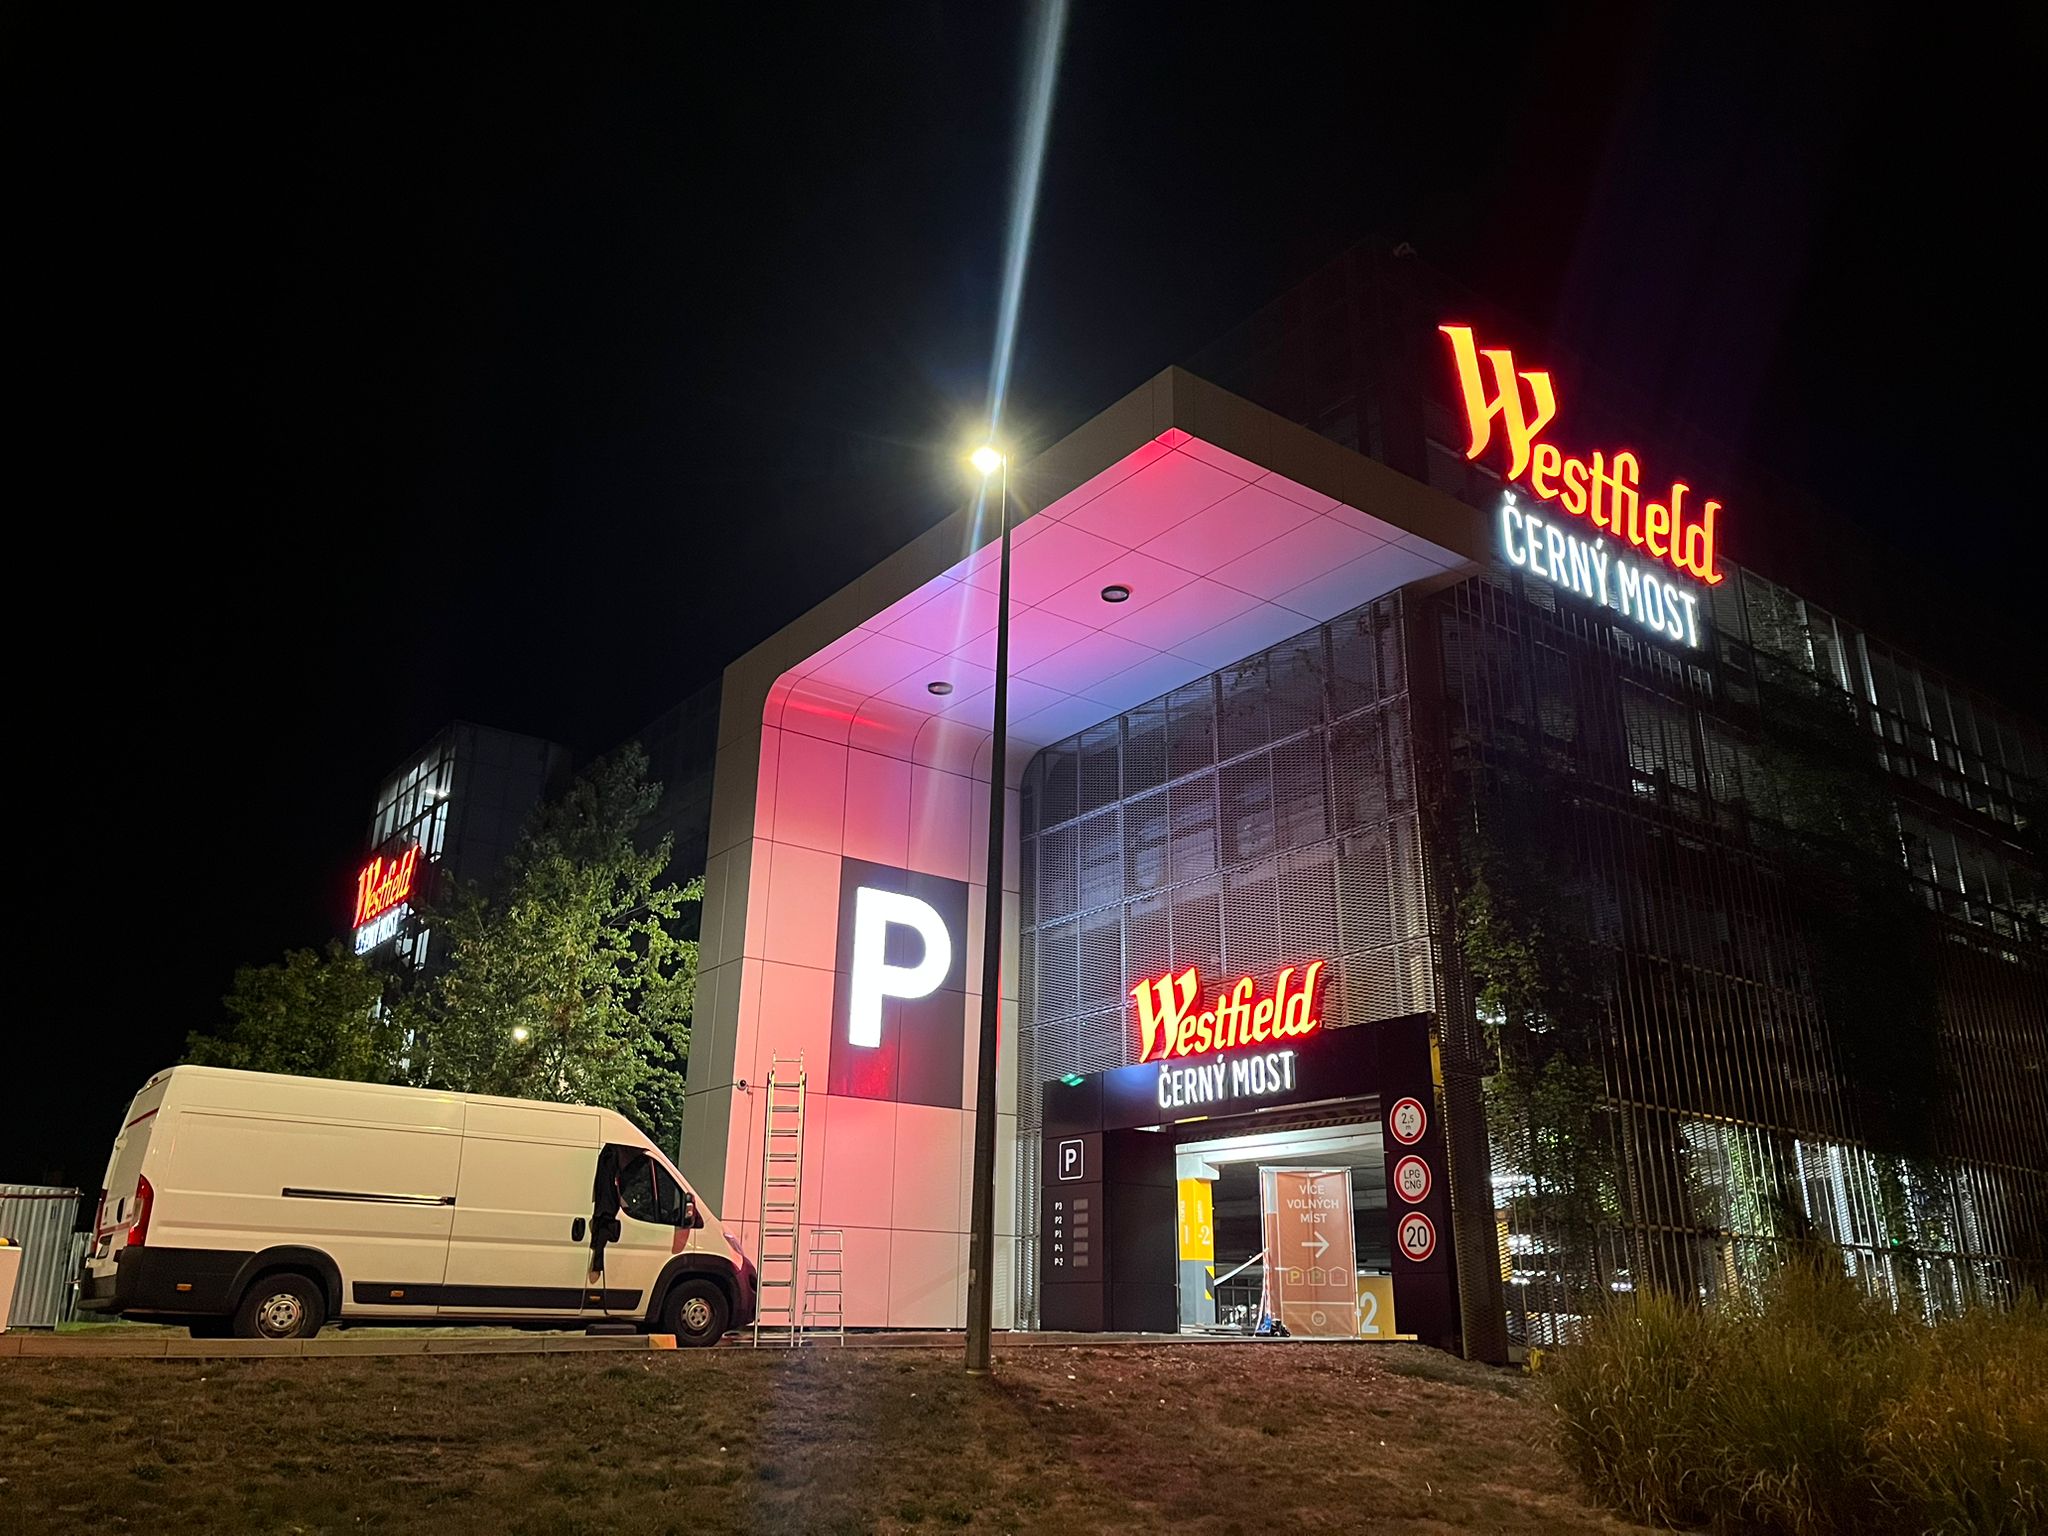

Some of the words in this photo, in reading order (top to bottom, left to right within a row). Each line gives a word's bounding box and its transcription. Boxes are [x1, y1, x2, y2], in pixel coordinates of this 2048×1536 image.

[1438, 324, 1723, 585] Westfield
[1502, 489, 1608, 606] ČERNÝ
[1617, 560, 1698, 648] MOST
[352, 844, 419, 929] Westfield
[849, 886, 952, 1048] P
[1129, 960, 1325, 1064] Westfield
[1158, 1054, 1226, 1109] ČERNÝ
[1232, 1050, 1294, 1097] MOST
[1065, 1148, 1077, 1172] P
[1404, 1169, 1420, 1179] LPG
[1404, 1180, 1421, 1190] CNG
[1055, 1202, 1063, 1211] P3
[1286, 1196, 1339, 1209] VOLNÝCH
[1055, 1216, 1063, 1225] P2
[1406, 1226, 1427, 1247] 20
